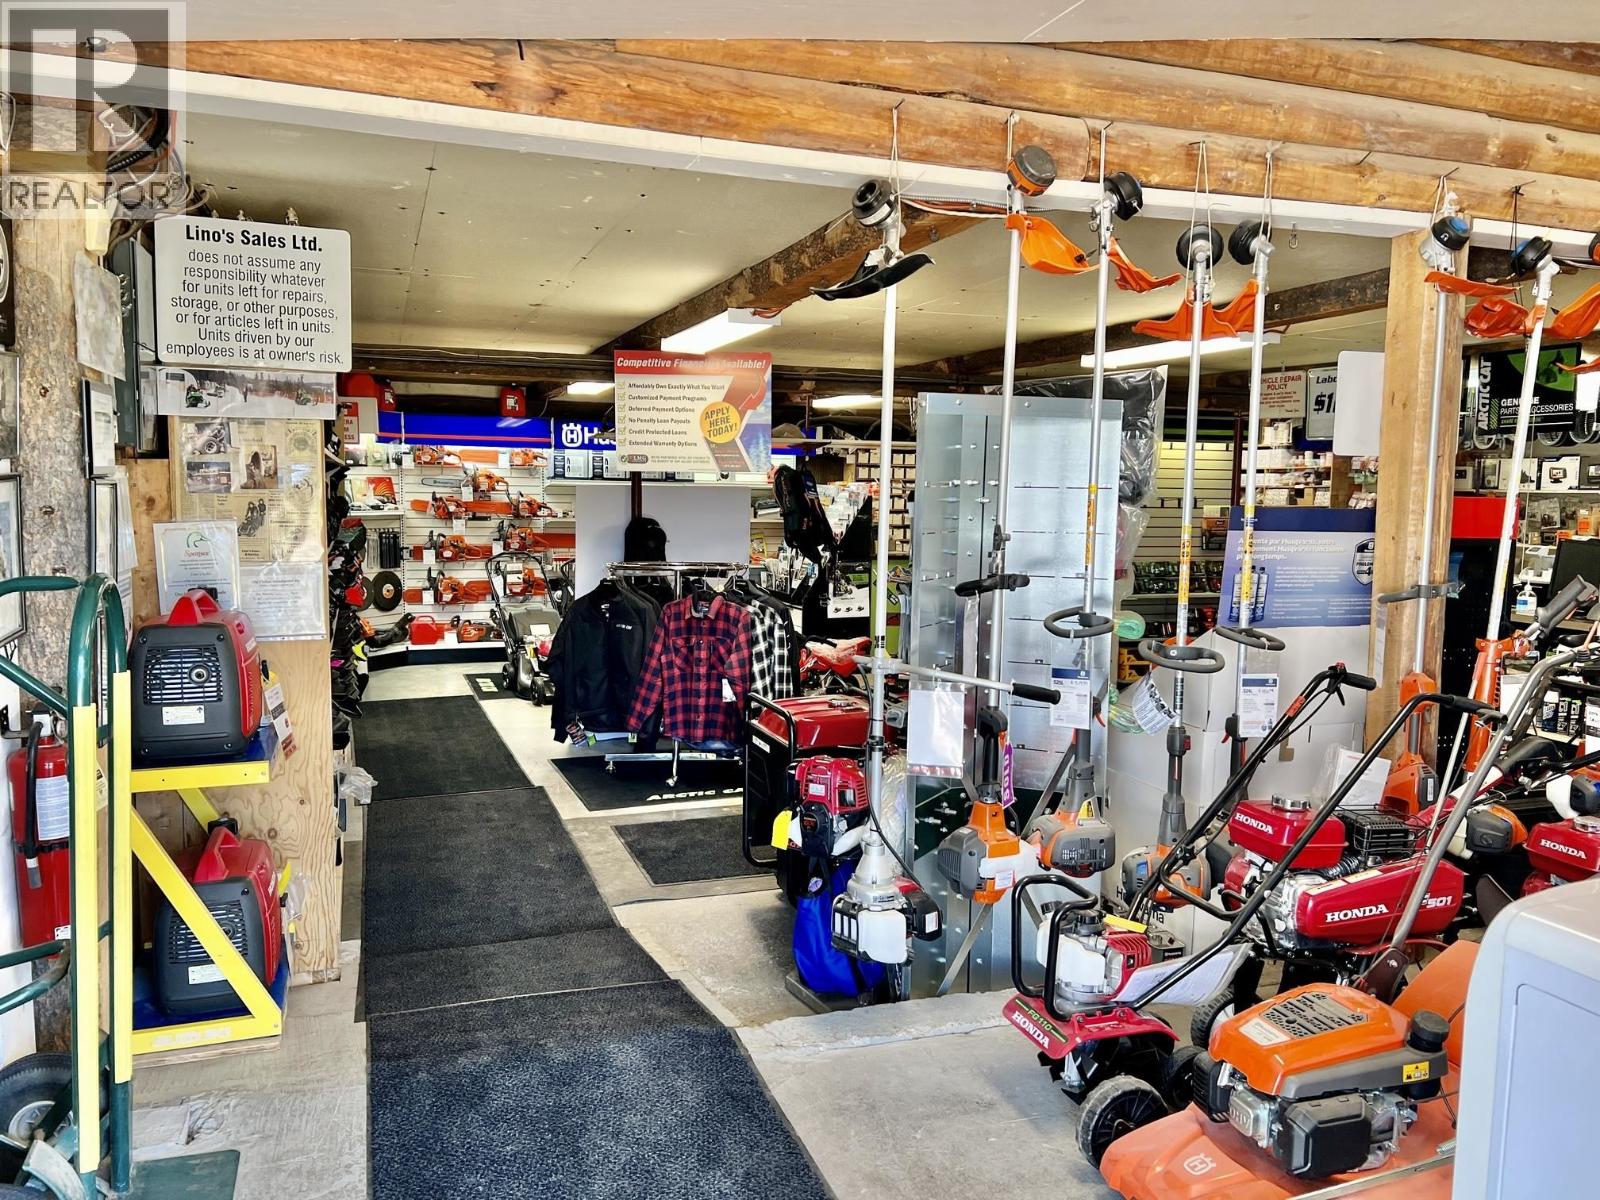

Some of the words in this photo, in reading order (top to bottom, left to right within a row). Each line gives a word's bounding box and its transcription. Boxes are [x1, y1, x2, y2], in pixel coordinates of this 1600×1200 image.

[186, 225, 234, 244] Lino's
[241, 230, 286, 248] Sales
[292, 235, 322, 251] Ltd.
[189, 249, 218, 263] does
[224, 254, 243, 265] not
[248, 256, 295, 269] assume
[300, 260, 321, 274] any
[184, 266, 266, 285] responsibility
[271, 273, 326, 287] whatever
[183, 280, 200, 292] for
[204, 282, 234, 296] units
[239, 285, 258, 297] left
[262, 287, 279, 299] for
[283, 289, 327, 304] repairs,
[171, 296, 222, 312] storage,
[227, 301, 239, 311] or
[244, 302, 275, 314] other
[279, 305, 338, 320] purposes,
[176, 312, 189, 323] or
[193, 313, 210, 324] for
[215, 315, 260, 328] articles
[265, 318, 283, 330] left
[288, 319, 298, 330] in
[302, 320, 333, 333] units.
[199, 328, 230, 341] Units
[235, 330, 271, 344] driven
[276, 333, 290, 348] by
[295, 337, 314, 346] our
[166, 343, 234, 358] employees
[239, 348, 249, 358] is
[254, 348, 264, 359] at
[269, 350, 315, 362] owner's
[320, 353, 344, 364] risk.
[616, 357, 672, 368] Competitive
[1482, 360, 1492, 384] CAT
[1266, 383, 1288, 391] POLICY
[704, 406, 730, 420] APPLY
[1478, 384, 1490, 430] ARCTIC
[1530, 404, 1574, 414] CCESSORIES
[708, 423, 737, 438] TODAY!
[709, 415, 731, 428] HERE
[646, 790, 716, 801] ARCTIC
[1234, 812, 1274, 835] HONDA
[1540, 838, 1588, 860] HONDA
[1325, 904, 1390, 923] HONDA
[1011, 1010, 1050, 1050] HONDA
[1026, 1009, 1053, 1032] FG110
